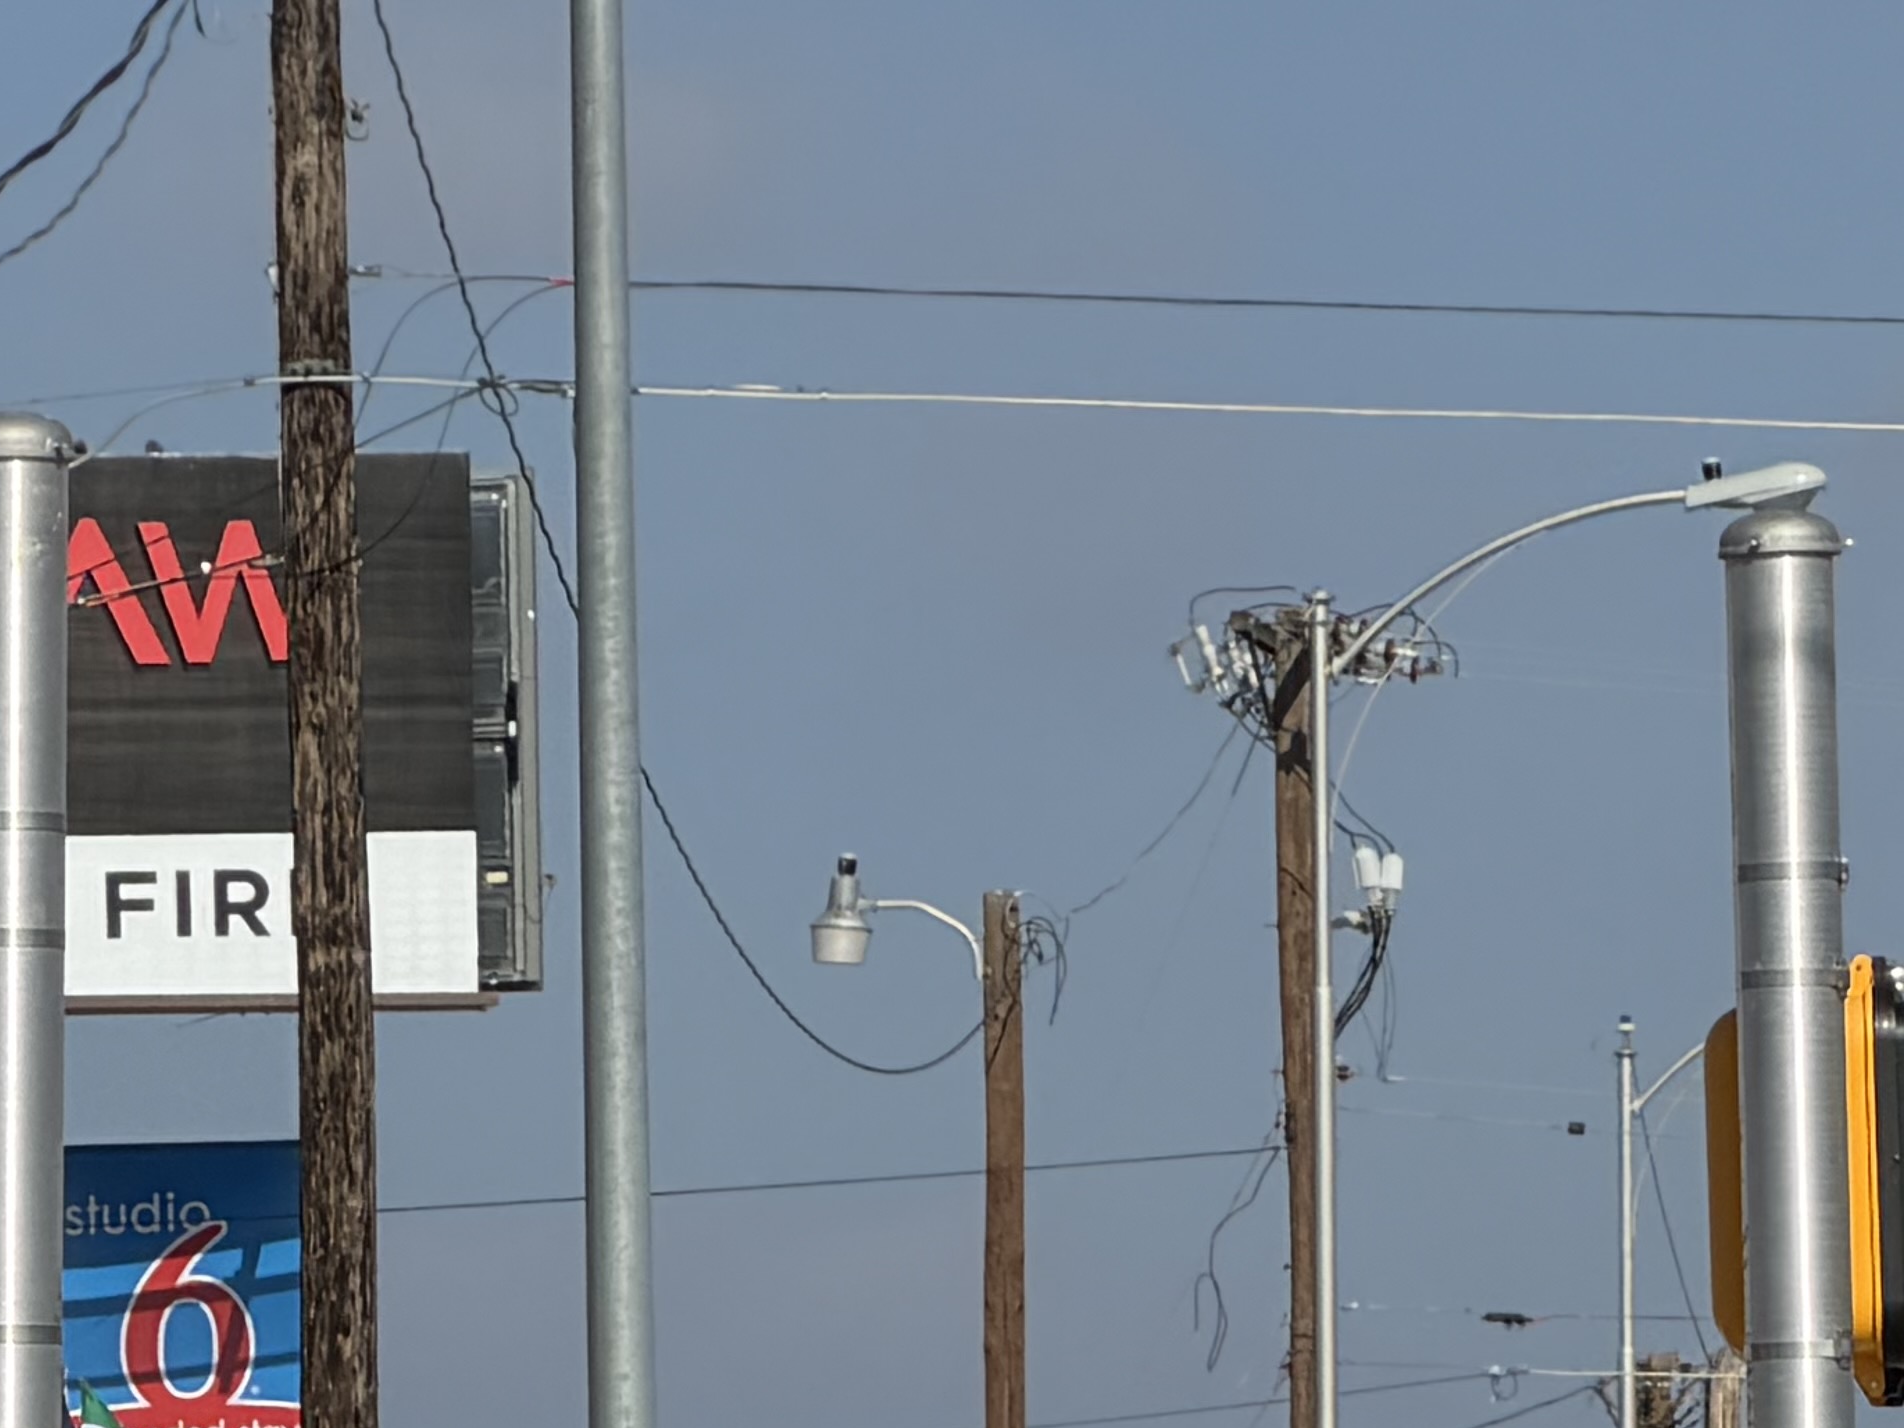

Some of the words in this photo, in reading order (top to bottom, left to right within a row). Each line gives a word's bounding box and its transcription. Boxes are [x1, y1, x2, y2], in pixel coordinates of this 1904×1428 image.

[105, 868, 298, 939] FIR
[64, 1192, 211, 1236] studio
[120, 1220, 256, 1404] 6
